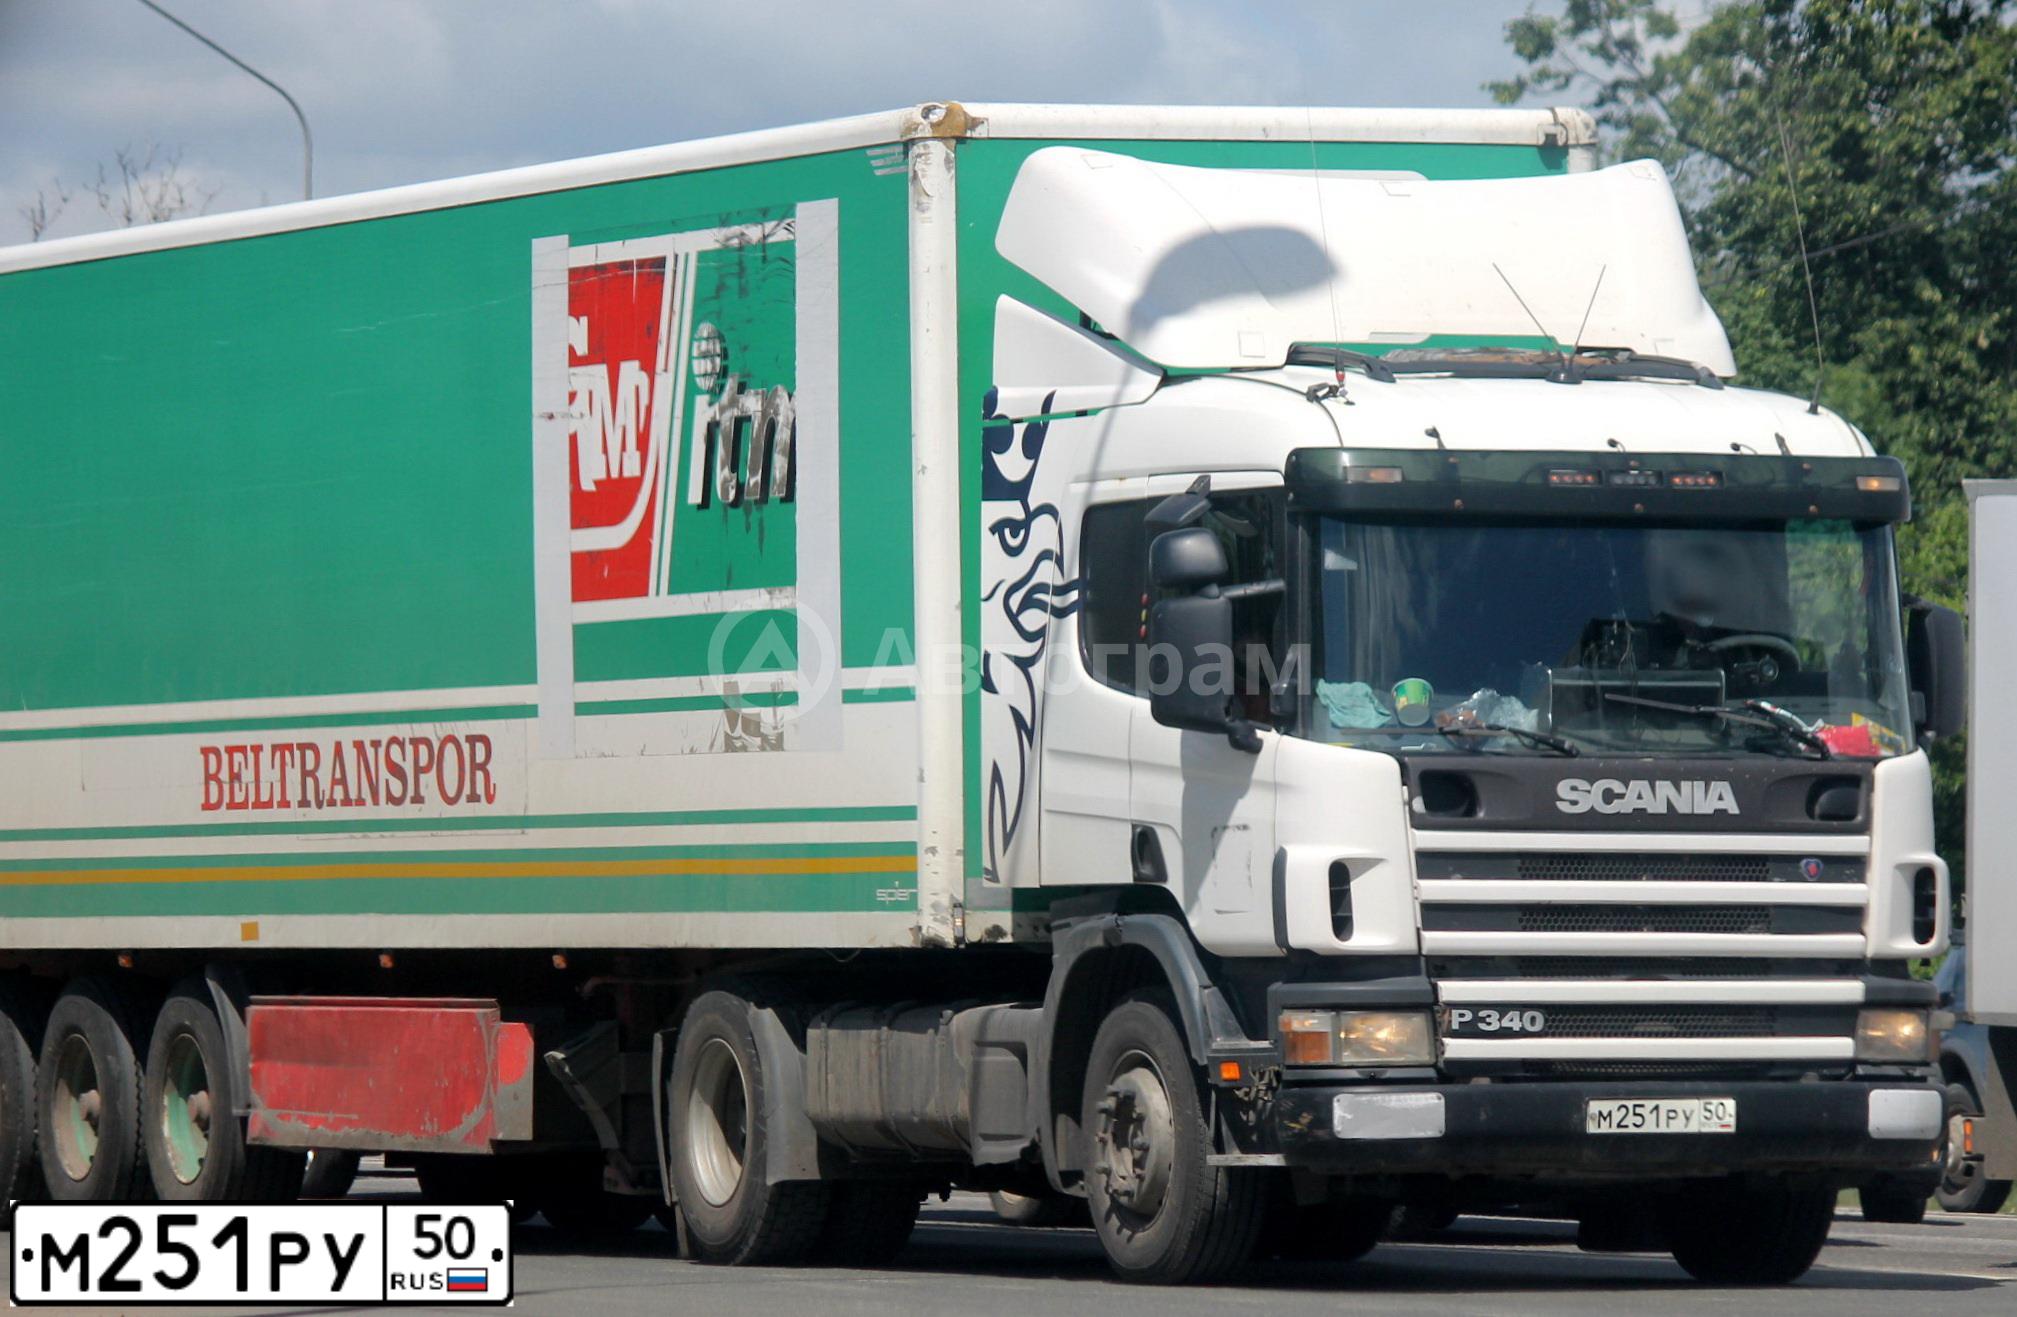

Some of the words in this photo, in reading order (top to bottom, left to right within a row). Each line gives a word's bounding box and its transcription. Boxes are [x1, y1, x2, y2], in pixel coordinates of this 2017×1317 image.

[200, 734, 496, 811] BELTRANSPOR
[1556, 779, 1740, 815] SCANIA
[1451, 1009, 1473, 1030] P
[1477, 1010, 1545, 1032] 340
